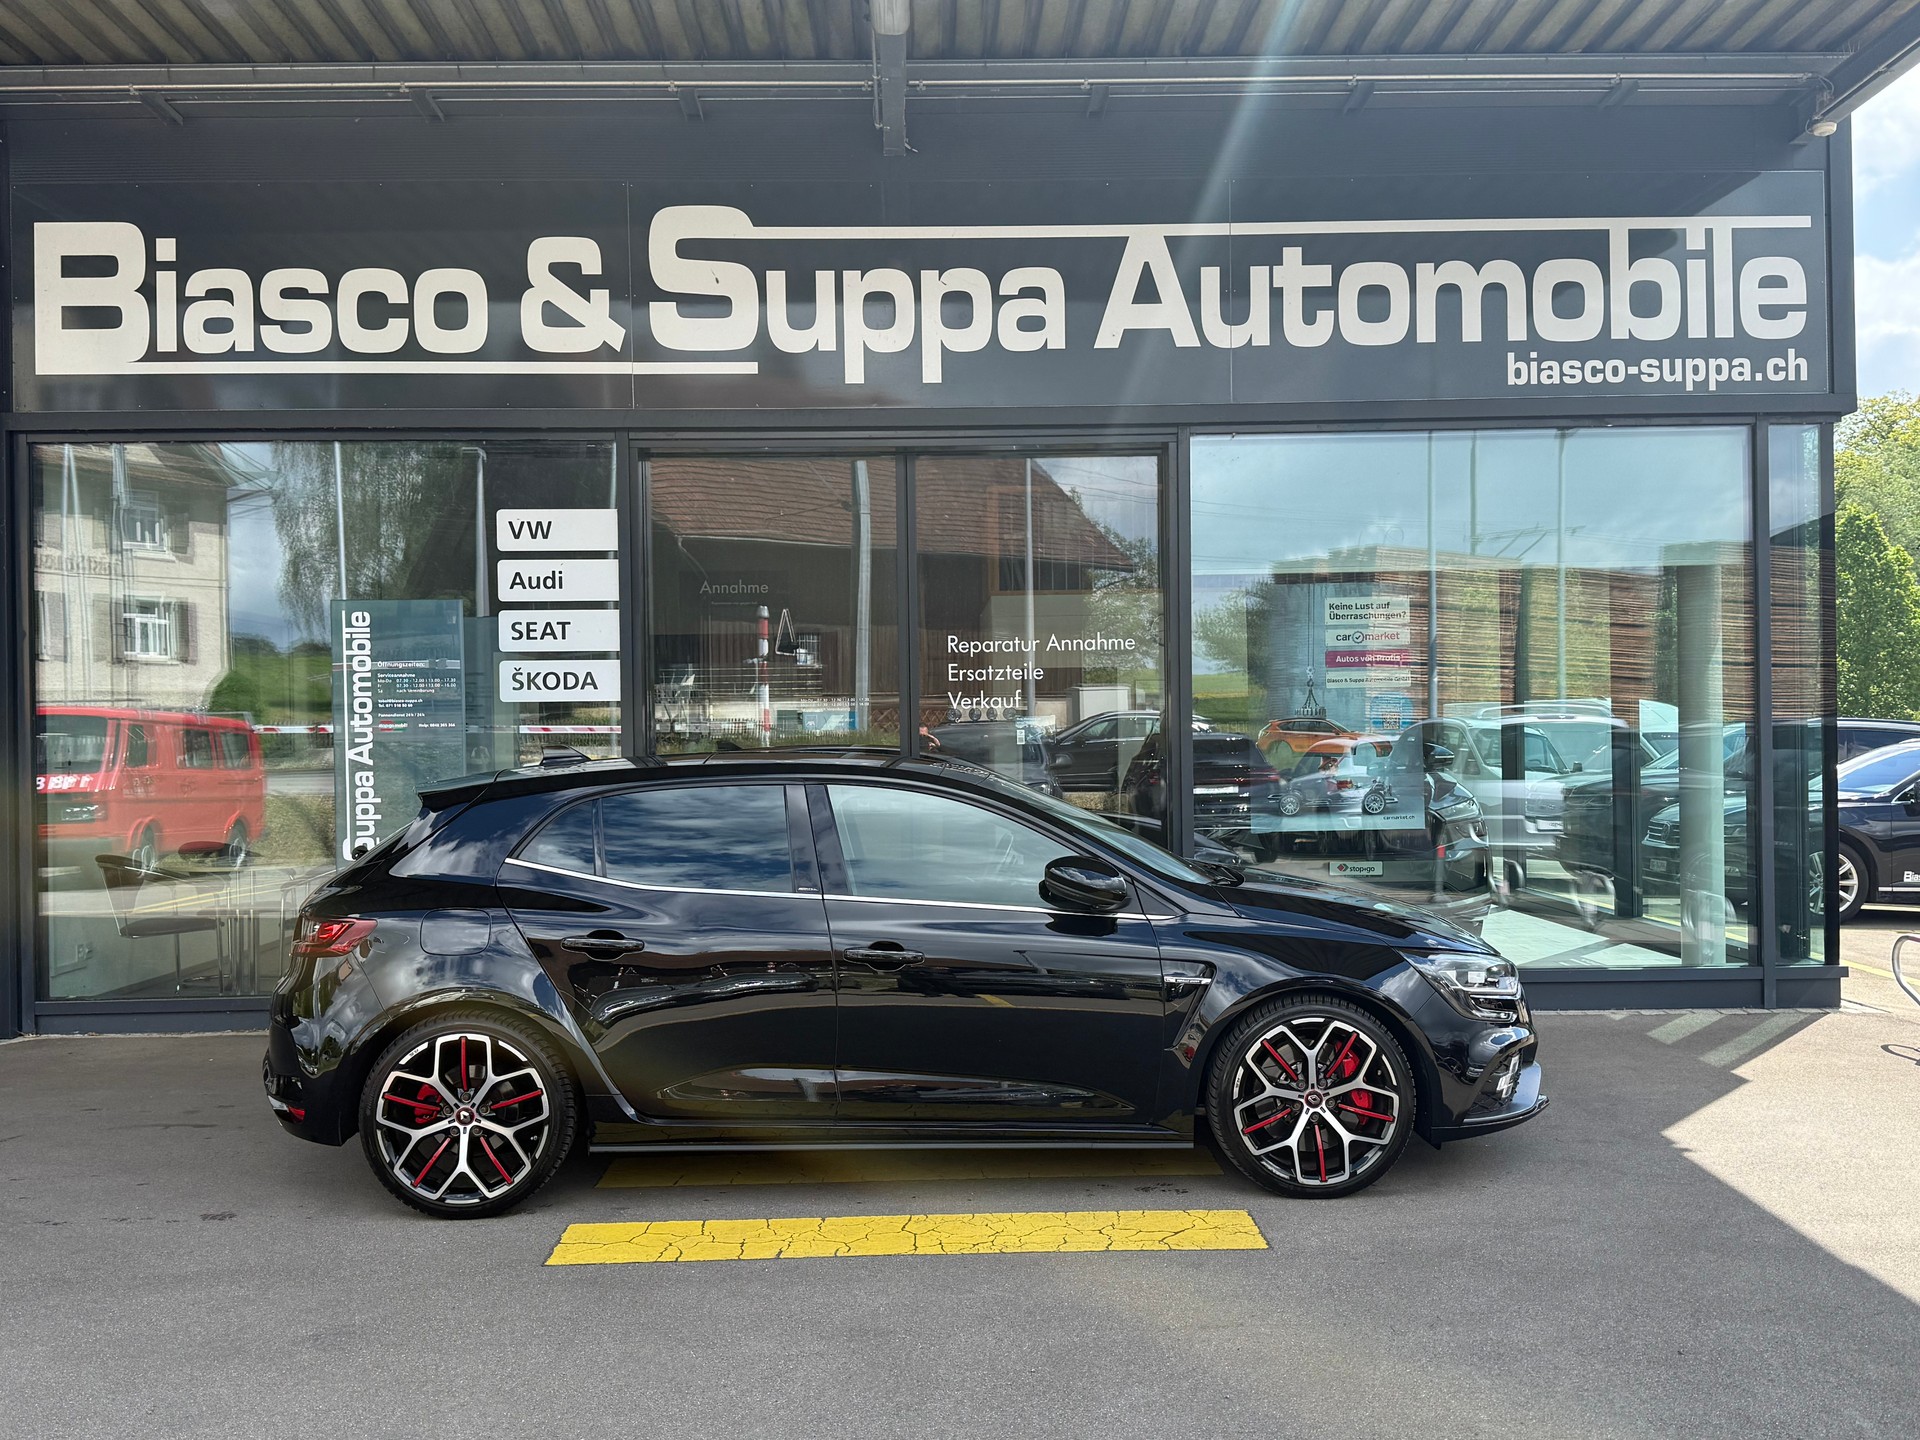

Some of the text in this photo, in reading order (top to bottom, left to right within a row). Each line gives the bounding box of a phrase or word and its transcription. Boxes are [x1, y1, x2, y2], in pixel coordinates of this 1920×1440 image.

[34, 205, 1808, 384] Biasco & Suppa Automobile
[1507, 349, 1808, 392] biasco-suppa.ch
[507, 520, 552, 540] VW
[509, 570, 563, 590] Audi
[699, 579, 769, 594] Annahme
[1328, 601, 1390, 611] Keine Lust auf
[1329, 611, 1407, 621] Überraschungen?
[511, 621, 571, 641] SEAT
[947, 632, 1136, 657] Reparatur Annahme
[377, 661, 426, 669] Öffnungszeiten:
[1335, 655, 1359, 663] Autos
[511, 667, 599, 690] ŠKODA
[947, 662, 1045, 683] Ersatzteile
[343, 611, 374, 766] Automobile
[948, 690, 1022, 710] Verkauf
